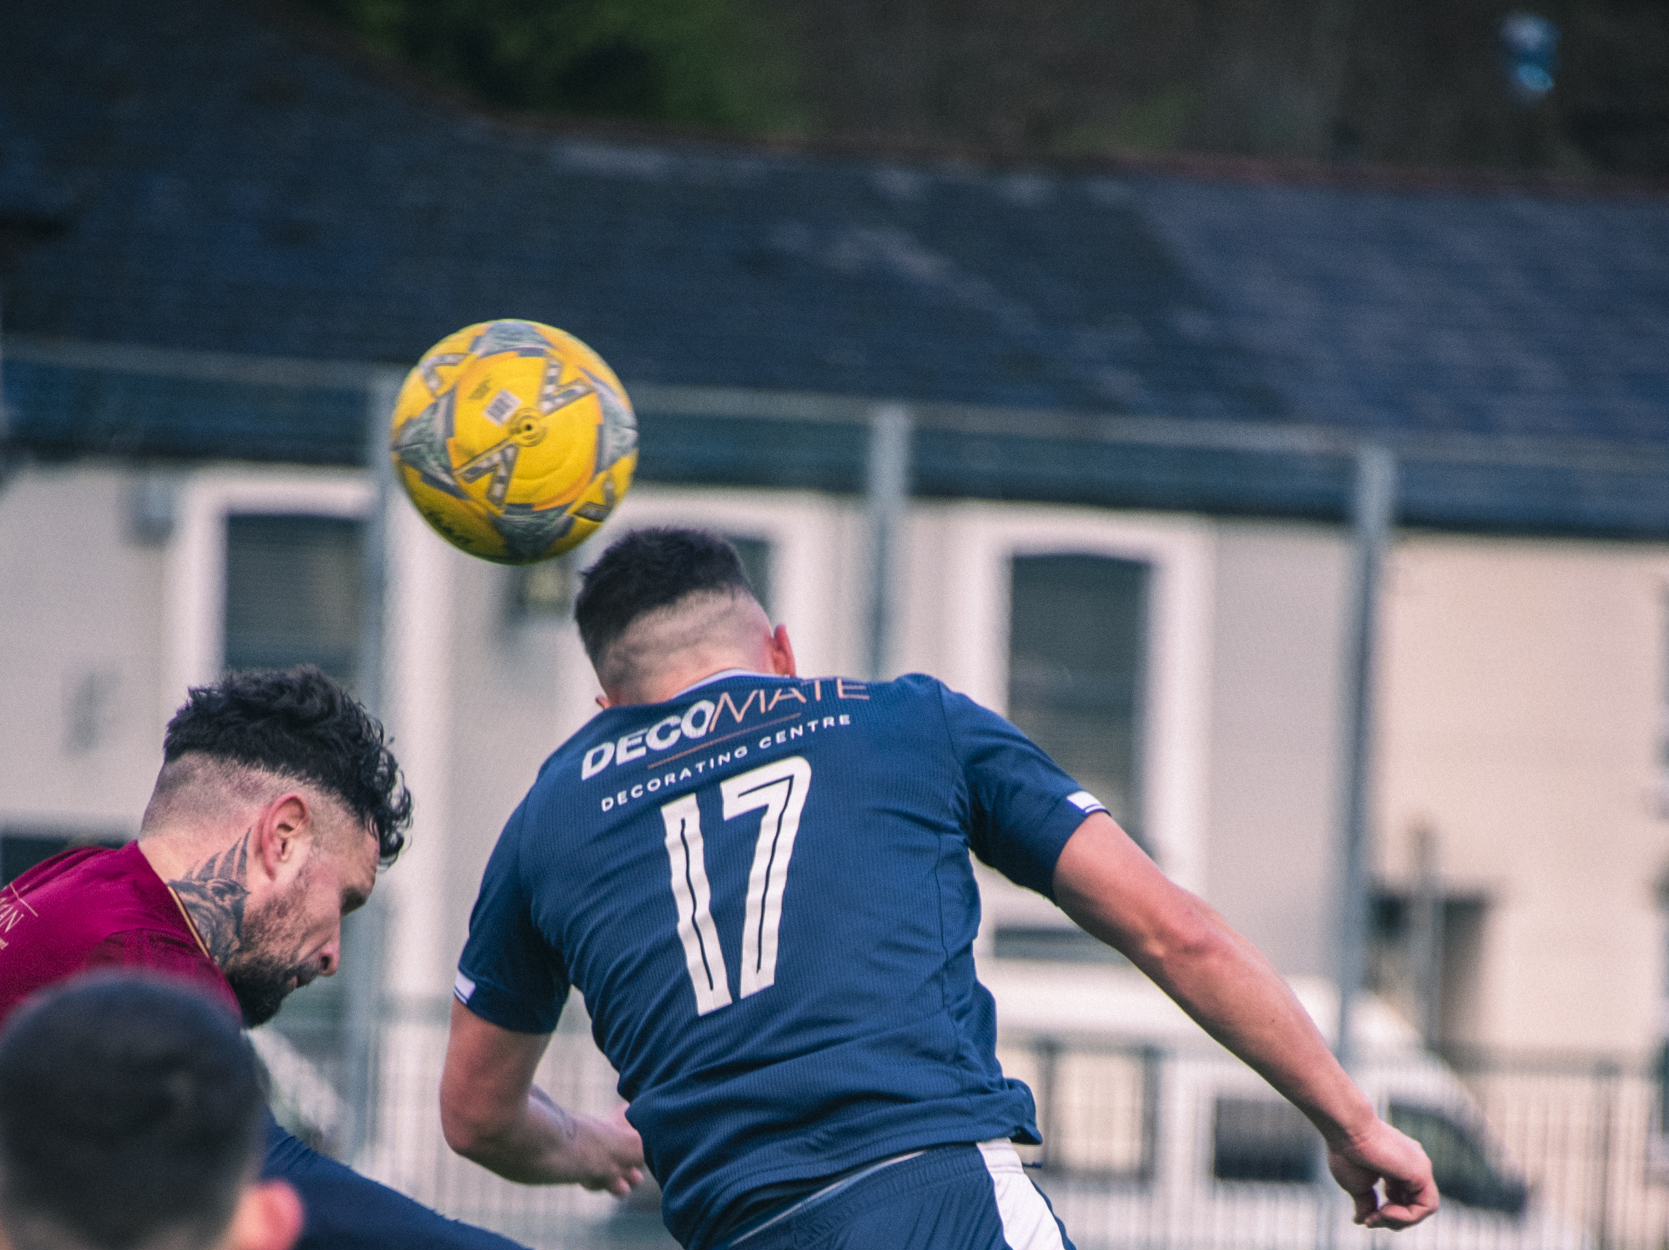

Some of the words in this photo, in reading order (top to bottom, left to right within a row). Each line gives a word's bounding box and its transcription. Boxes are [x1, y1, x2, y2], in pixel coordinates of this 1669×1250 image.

[581, 677, 869, 780] DECOMATE
[601, 746, 748, 812] DECORATING
[758, 714, 851, 750] CENTRE
[660, 755, 812, 1016] 17
